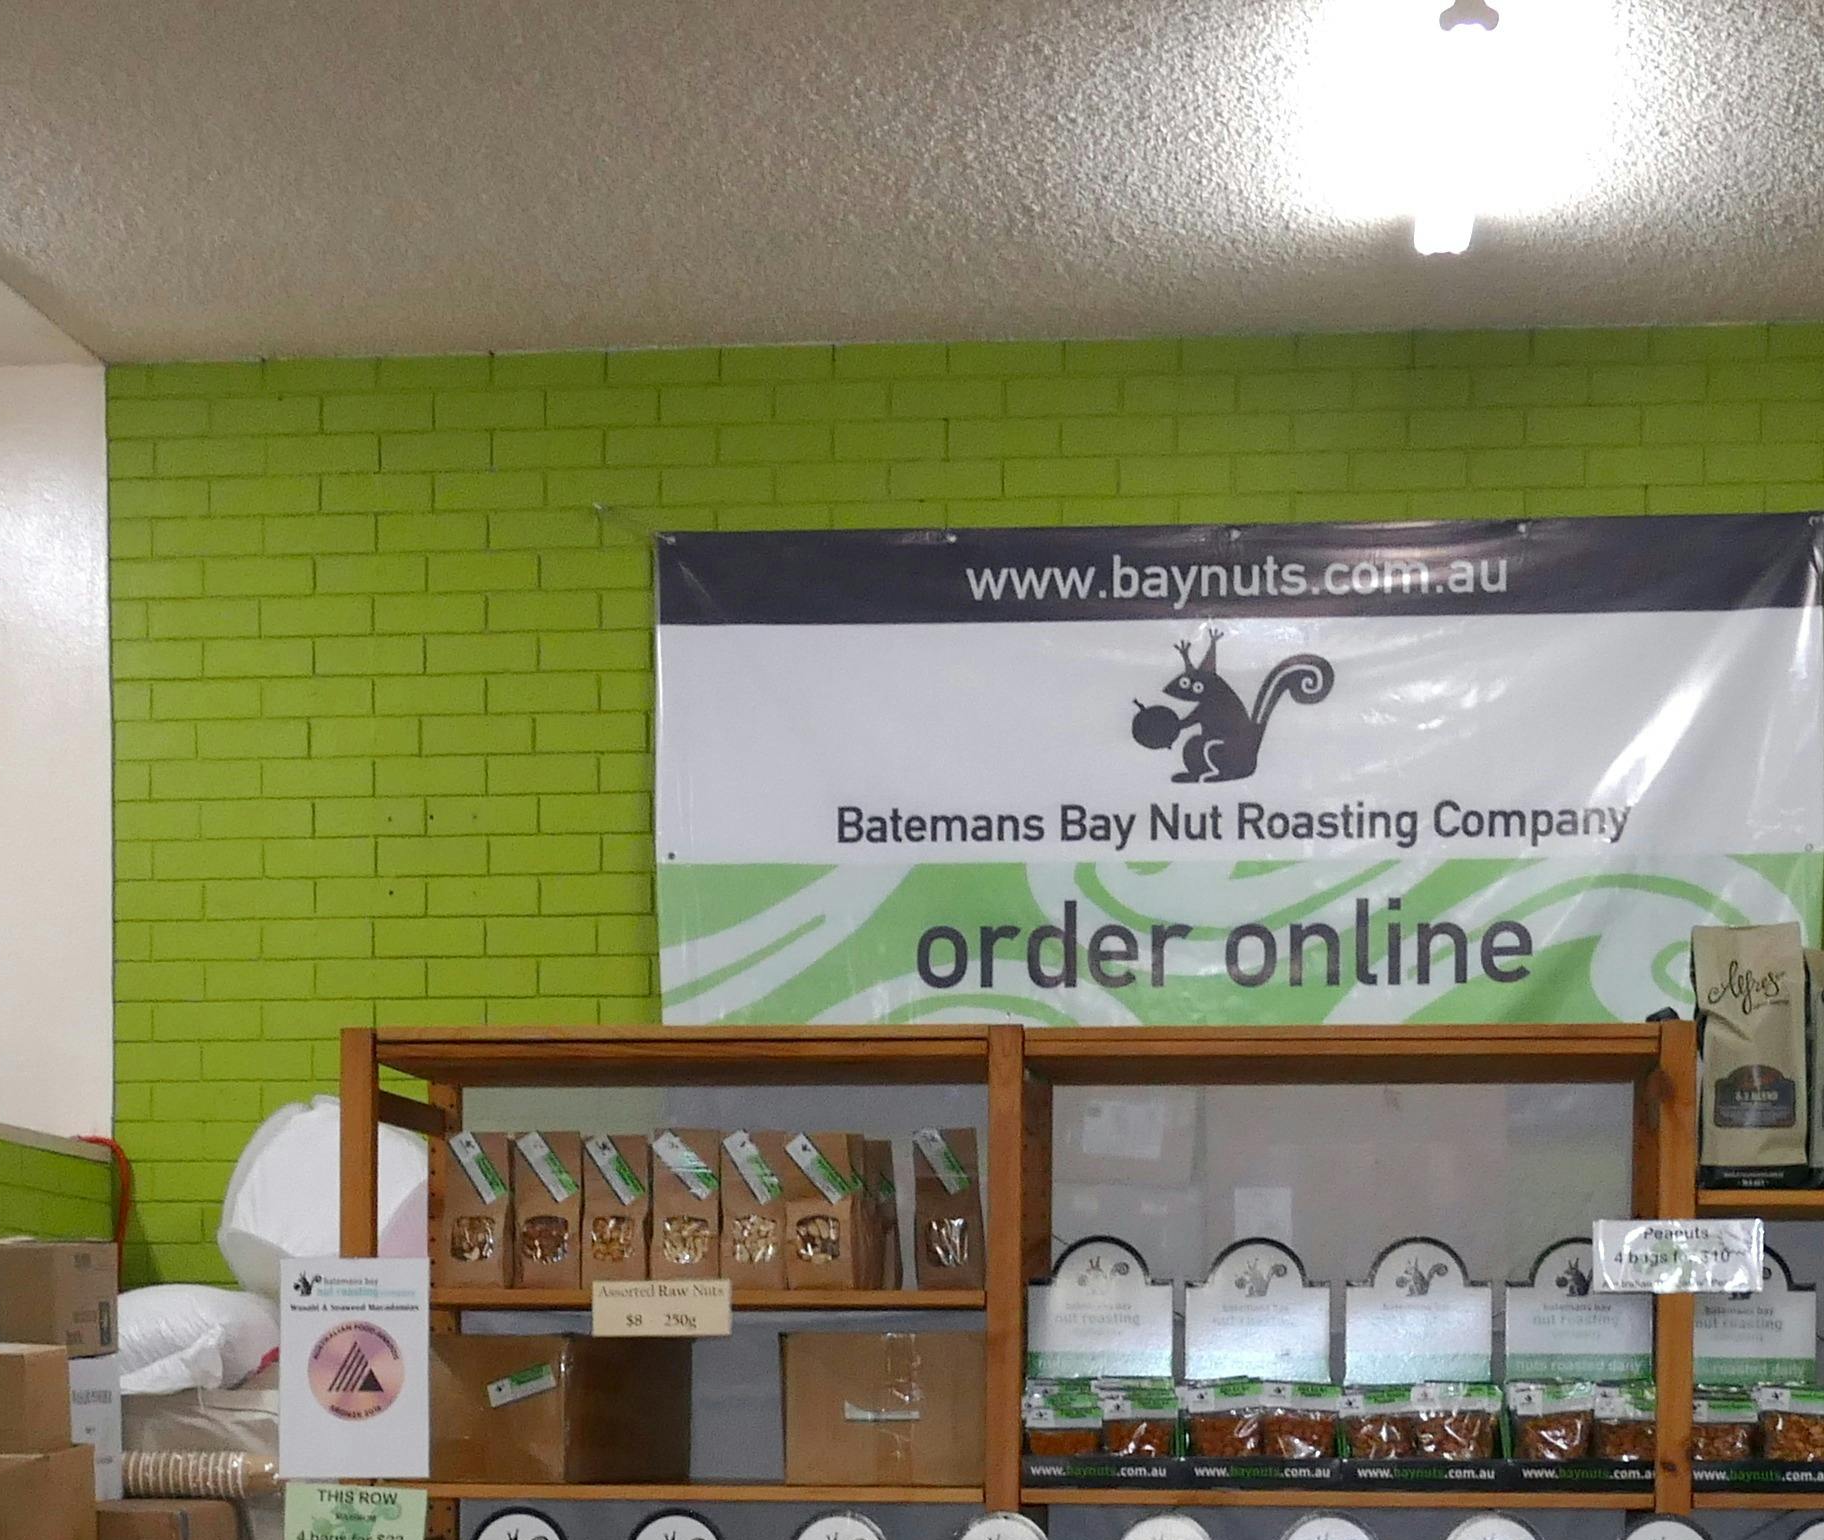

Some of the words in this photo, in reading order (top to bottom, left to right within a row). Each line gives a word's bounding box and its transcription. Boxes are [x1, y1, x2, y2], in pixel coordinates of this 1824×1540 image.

[965, 555, 1509, 609] www.baynuts.com.au
[837, 806, 1045, 844] Batemans
[1060, 805, 1136, 852] Bay
[1150, 803, 1224, 841] Nut
[1238, 801, 1419, 847] Roasting
[1433, 800, 1632, 846] Company
[916, 901, 1194, 989] order
[1225, 896, 1533, 989] online
[599, 1284, 655, 1298] Assorted
[658, 1284, 687, 1298] Raw
[693, 1283, 724, 1297] Nuts
[626, 1313, 643, 1327] $8
[664, 1313, 697, 1328] 250g
[319, 1489, 354, 1503] THIS
[358, 1490, 398, 1505] ROW
